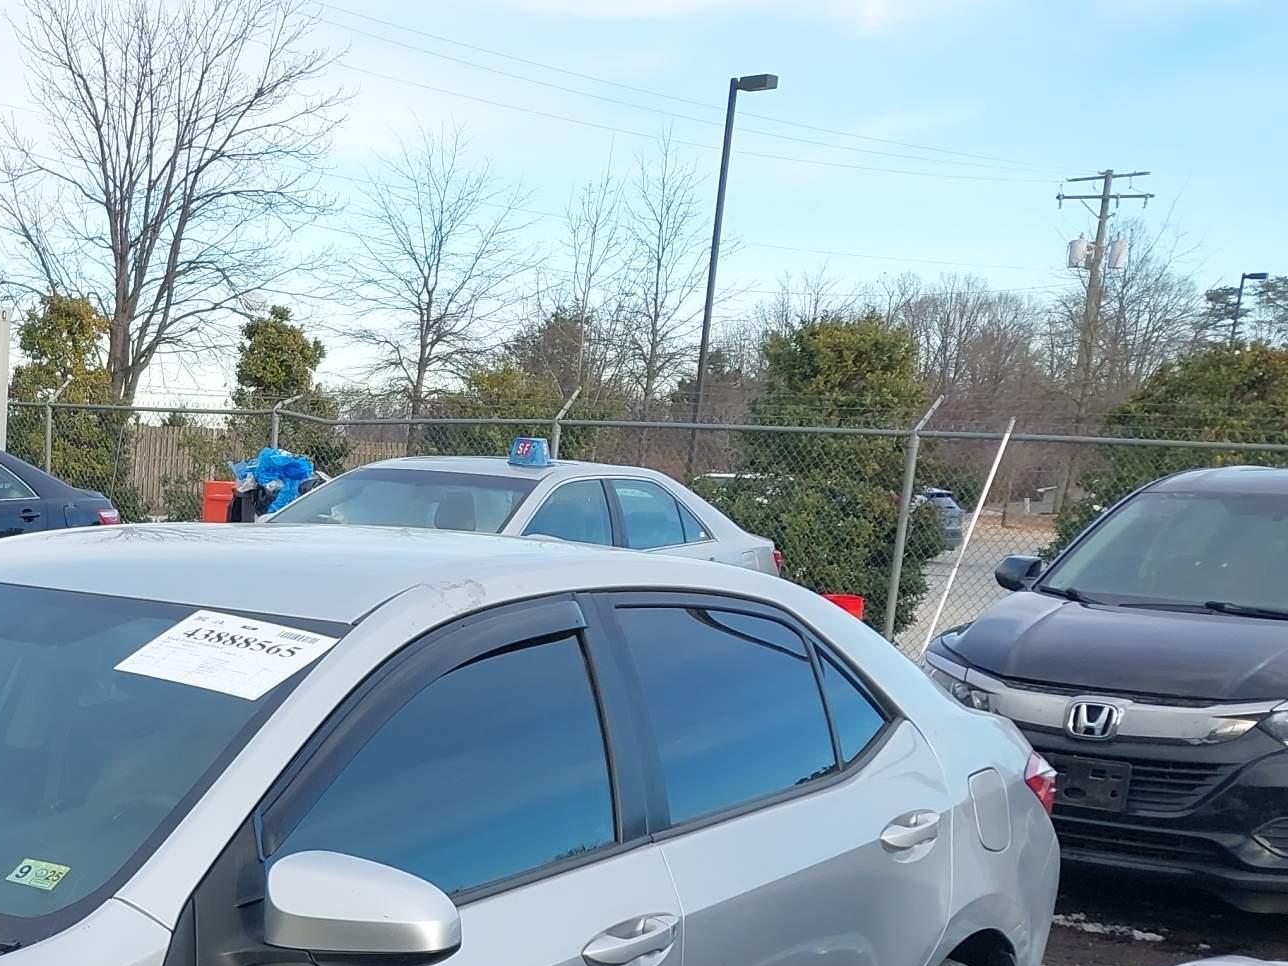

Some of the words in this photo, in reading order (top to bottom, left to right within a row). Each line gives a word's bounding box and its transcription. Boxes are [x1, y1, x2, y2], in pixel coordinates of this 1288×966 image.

[517, 442, 530, 455] SF
[183, 627, 303, 659] 43888565
[15, 864, 32, 879] 9
[45, 870, 63, 882] 25
